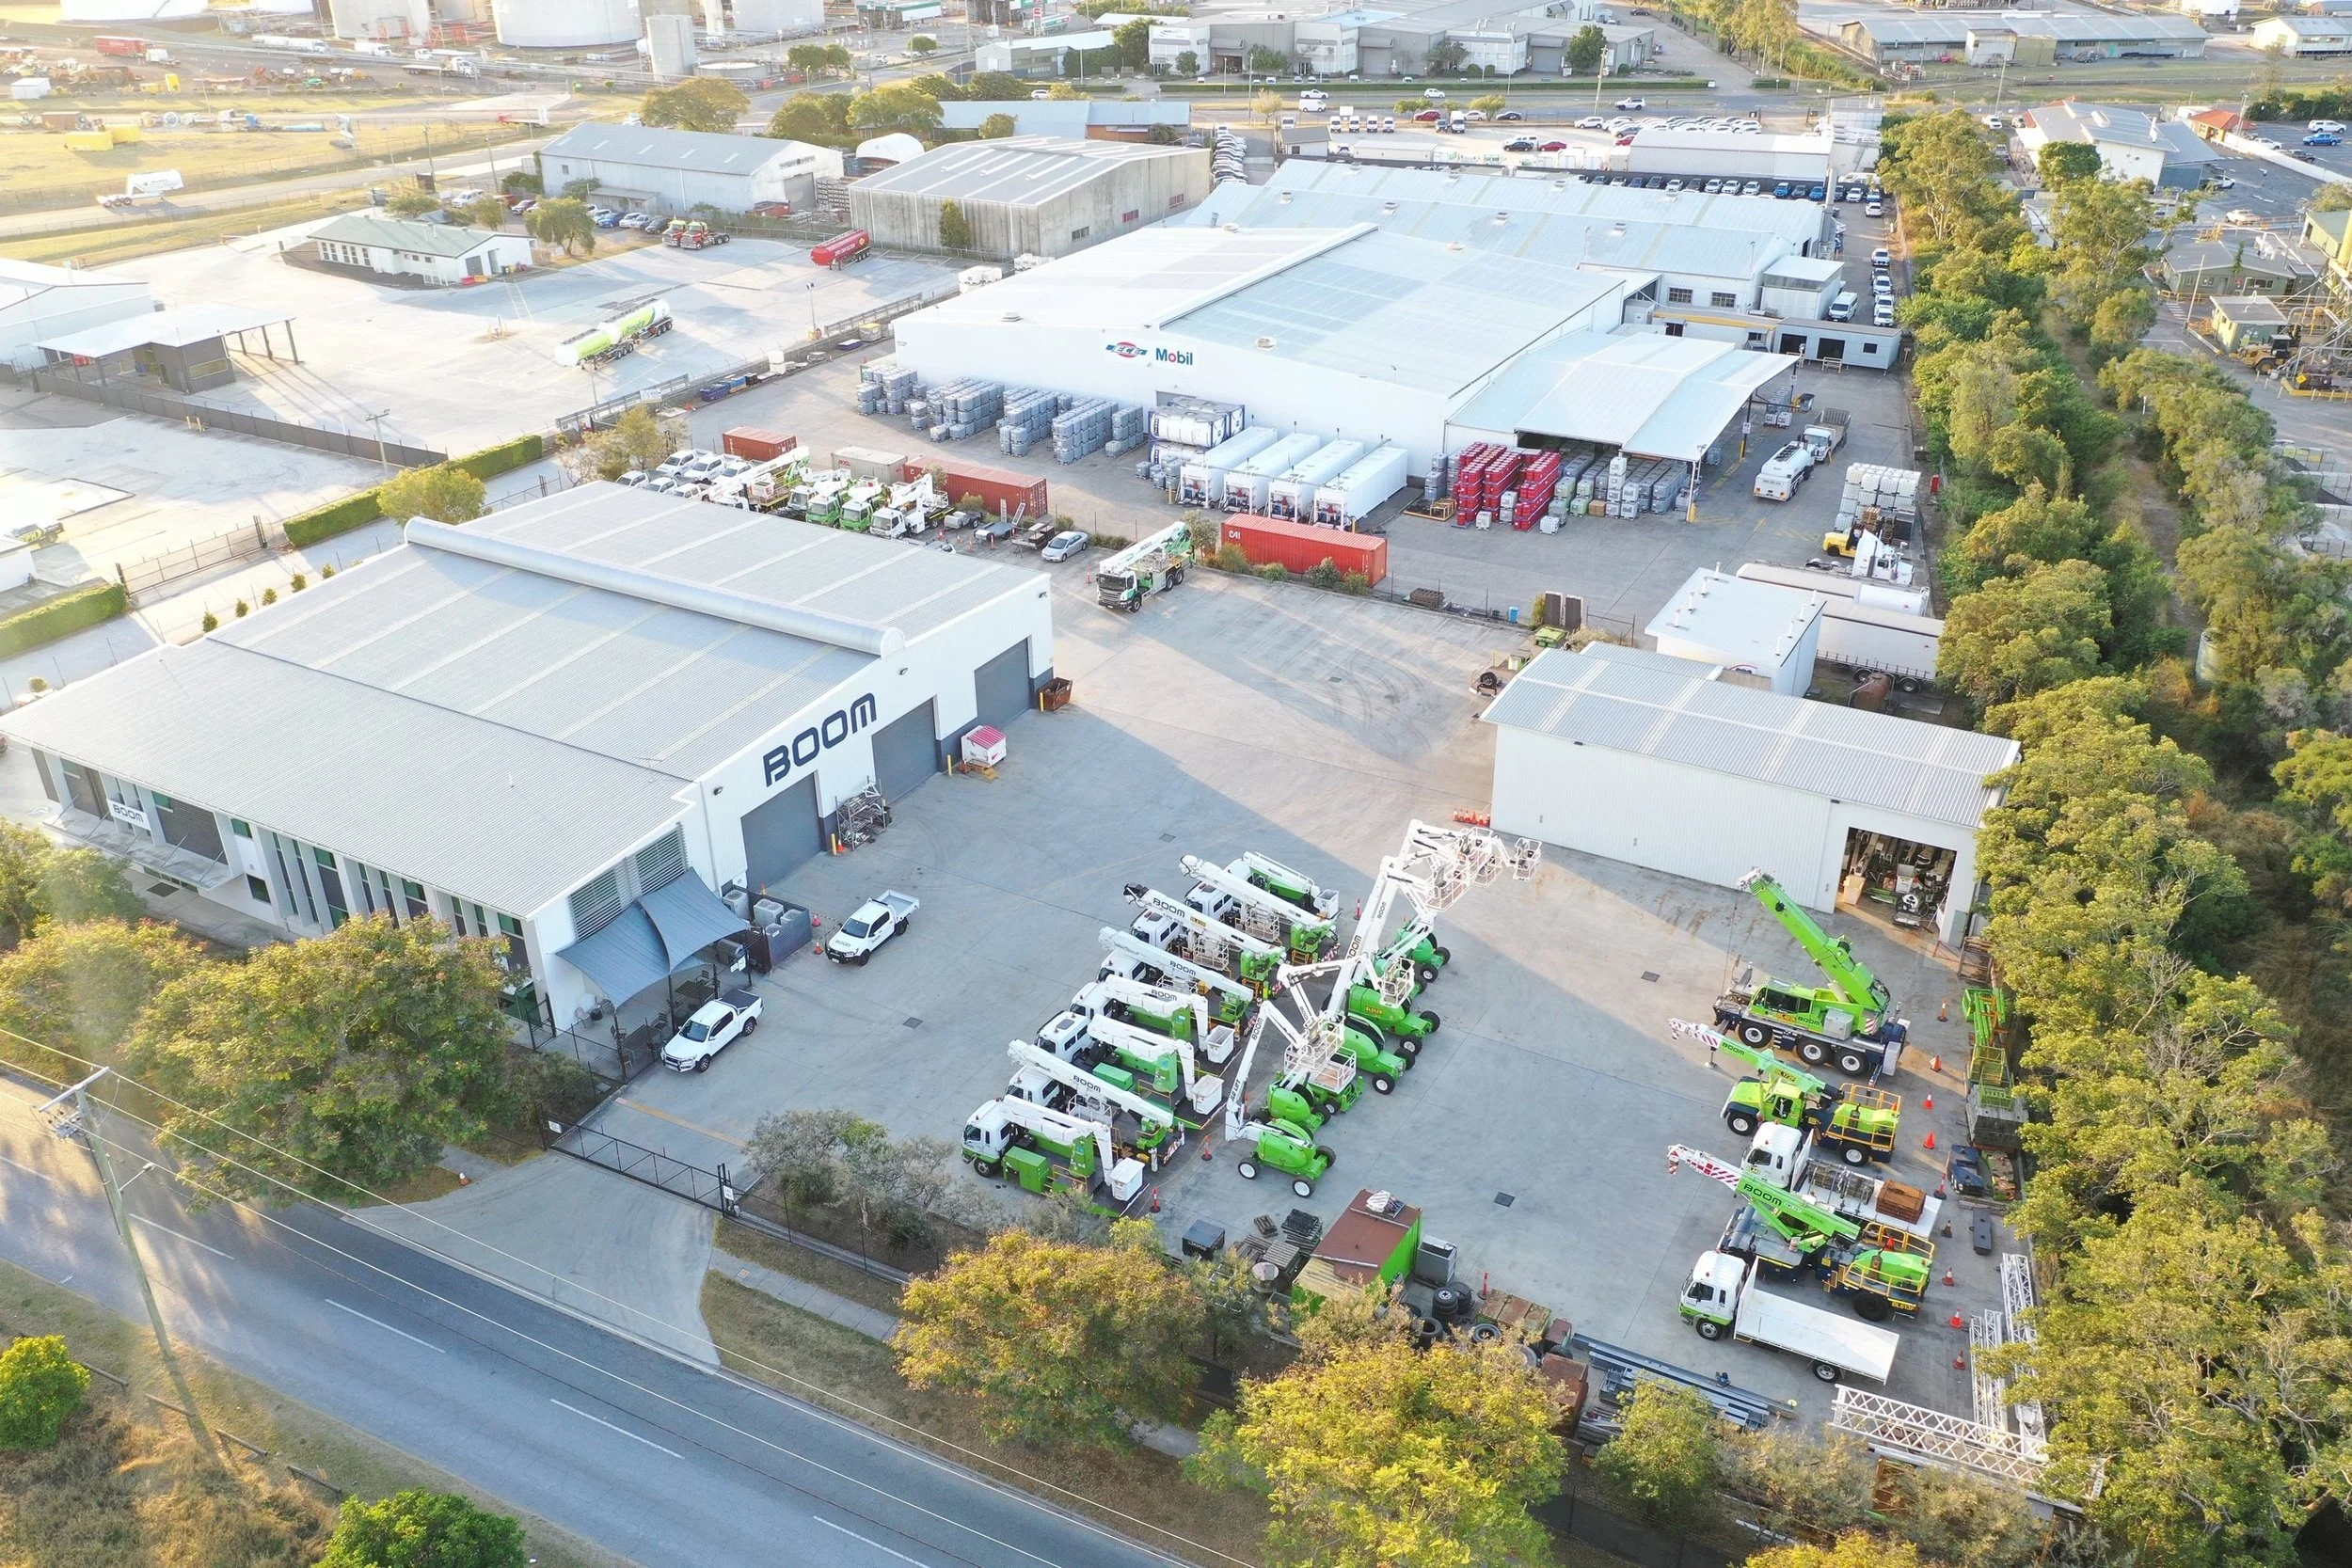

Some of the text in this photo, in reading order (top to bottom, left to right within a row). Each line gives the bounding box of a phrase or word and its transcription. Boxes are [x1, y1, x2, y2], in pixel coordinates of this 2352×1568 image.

[1156, 347, 1193, 365] Mobil
[1229, 530, 1241, 540] CAI
[763, 692, 877, 787] BOOM
[112, 804, 144, 823] BOOM
[1152, 897, 1185, 918] BOOM
[1169, 960, 1197, 976] BOOM
[1151, 989, 1178, 1002] BOOM
[1251, 1018, 1263, 1040] BOOM
[1798, 1016, 1820, 1026] BOOM
[1722, 1042, 1745, 1055] BOOM
[1073, 1074, 1102, 1093] BOOM
[1743, 1183, 1783, 1207] BOOM
